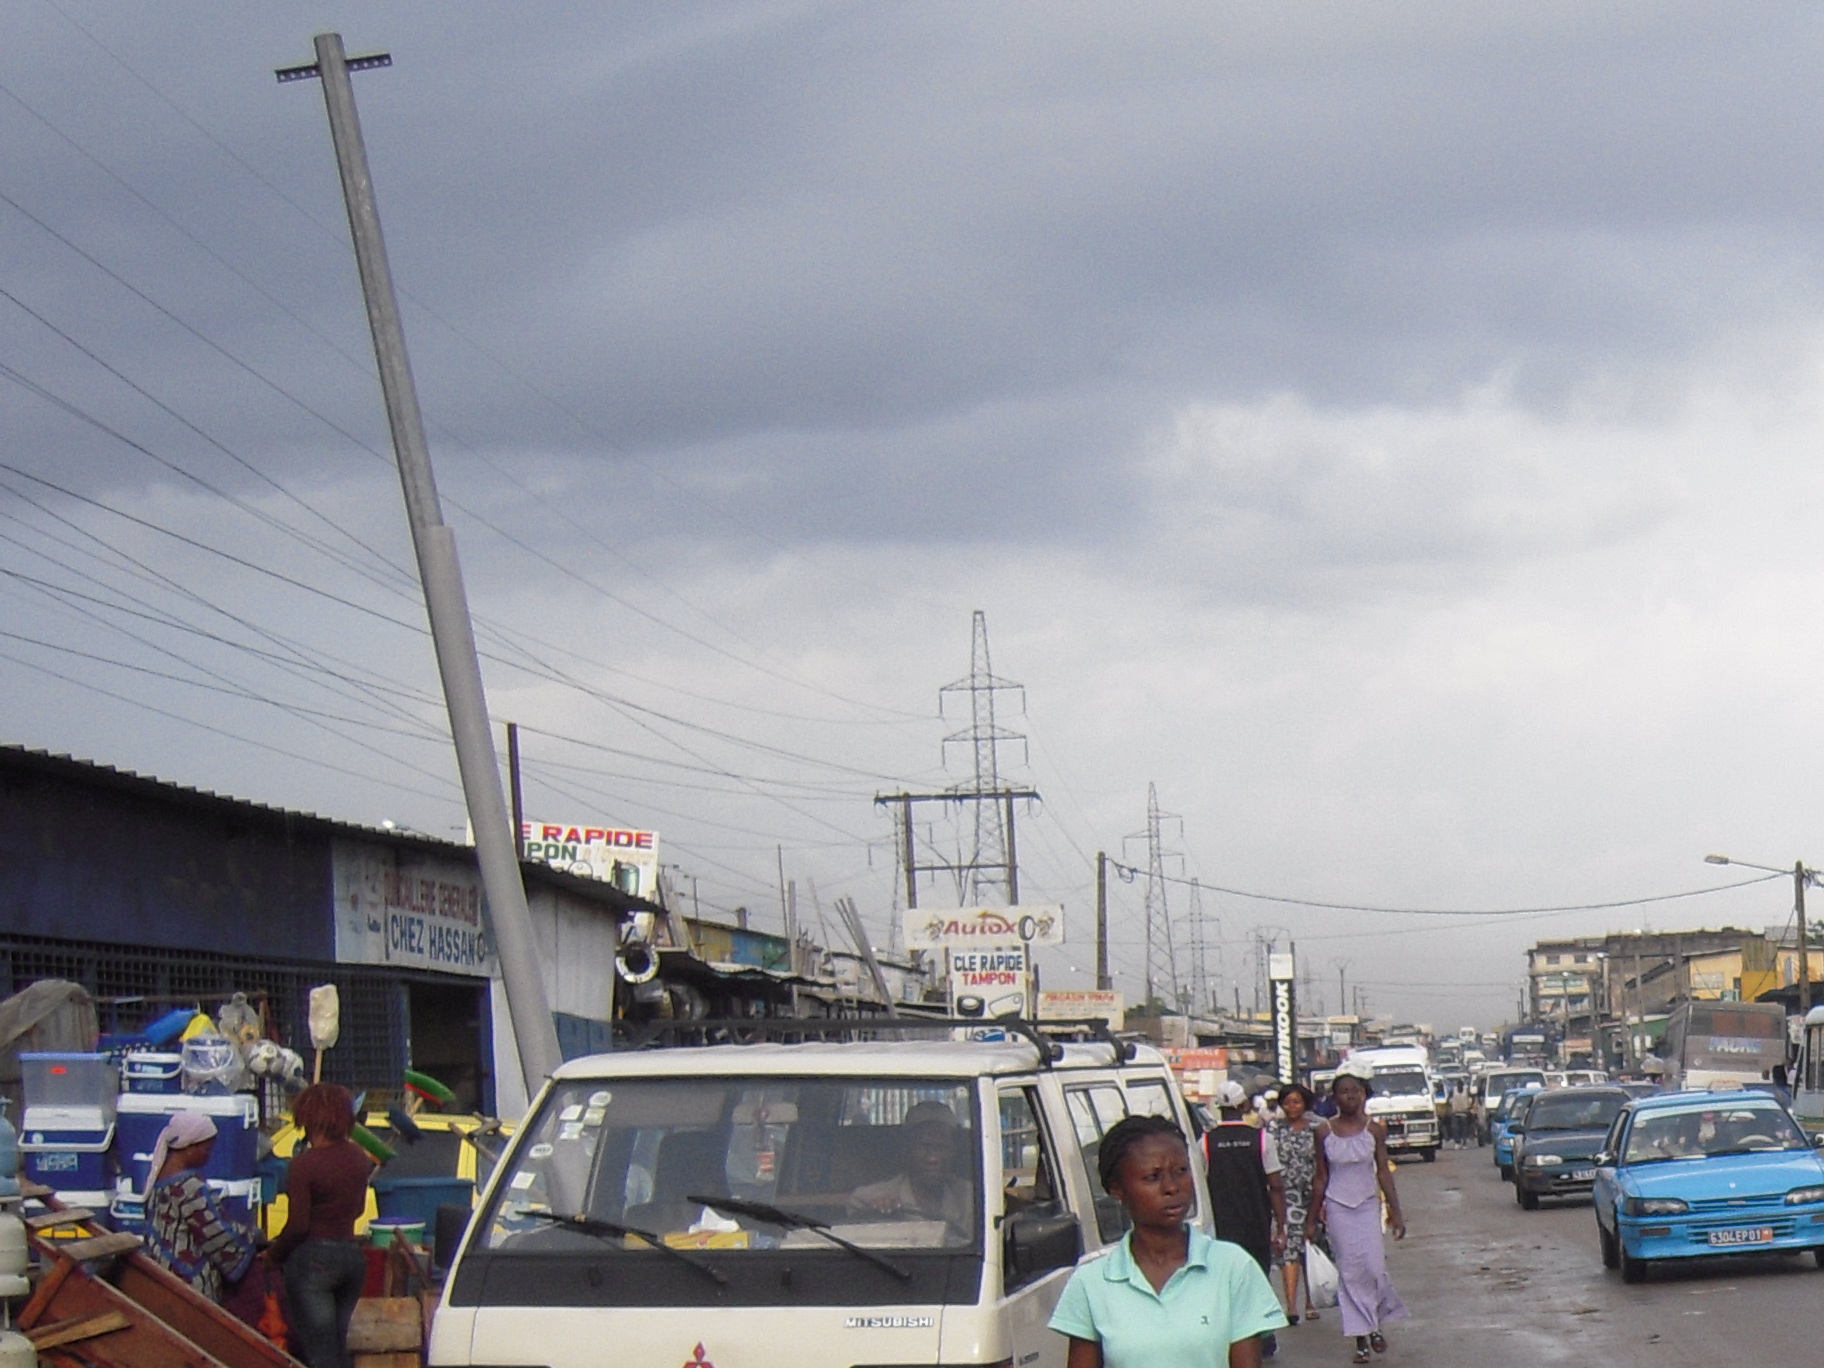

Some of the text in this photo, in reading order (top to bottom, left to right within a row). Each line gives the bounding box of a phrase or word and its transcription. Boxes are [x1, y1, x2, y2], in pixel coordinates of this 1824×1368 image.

[542, 824, 653, 850] RAPIDE
[527, 842, 578, 862] PON
[391, 914, 425, 955] CHEZ
[953, 954, 1023, 972] CLE RAPIDE
[962, 972, 1017, 986] TAMPON
[844, 1316, 935, 1329] MITSUBISHI
